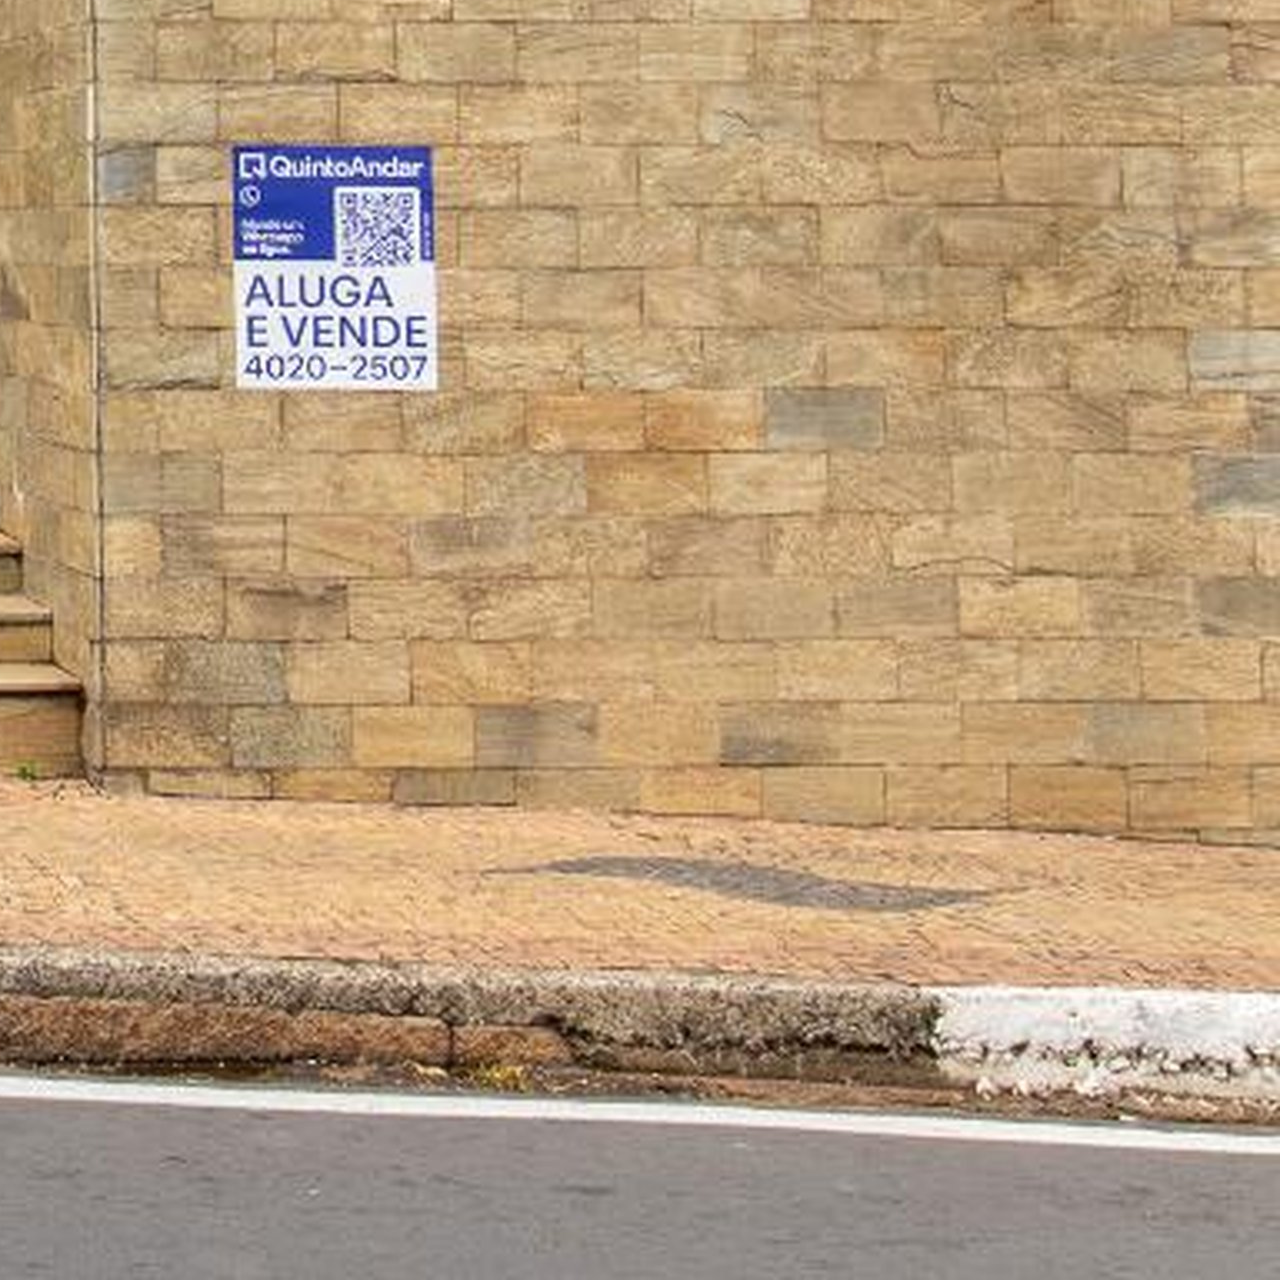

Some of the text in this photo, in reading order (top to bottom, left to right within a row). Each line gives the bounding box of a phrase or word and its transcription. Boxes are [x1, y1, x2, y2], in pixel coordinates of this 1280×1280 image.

[269, 155, 424, 179] QuintoAndar
[245, 275, 394, 308] ALUGA
[247, 316, 428, 348] E VENDE
[244, 355, 428, 381] 4020-2507
